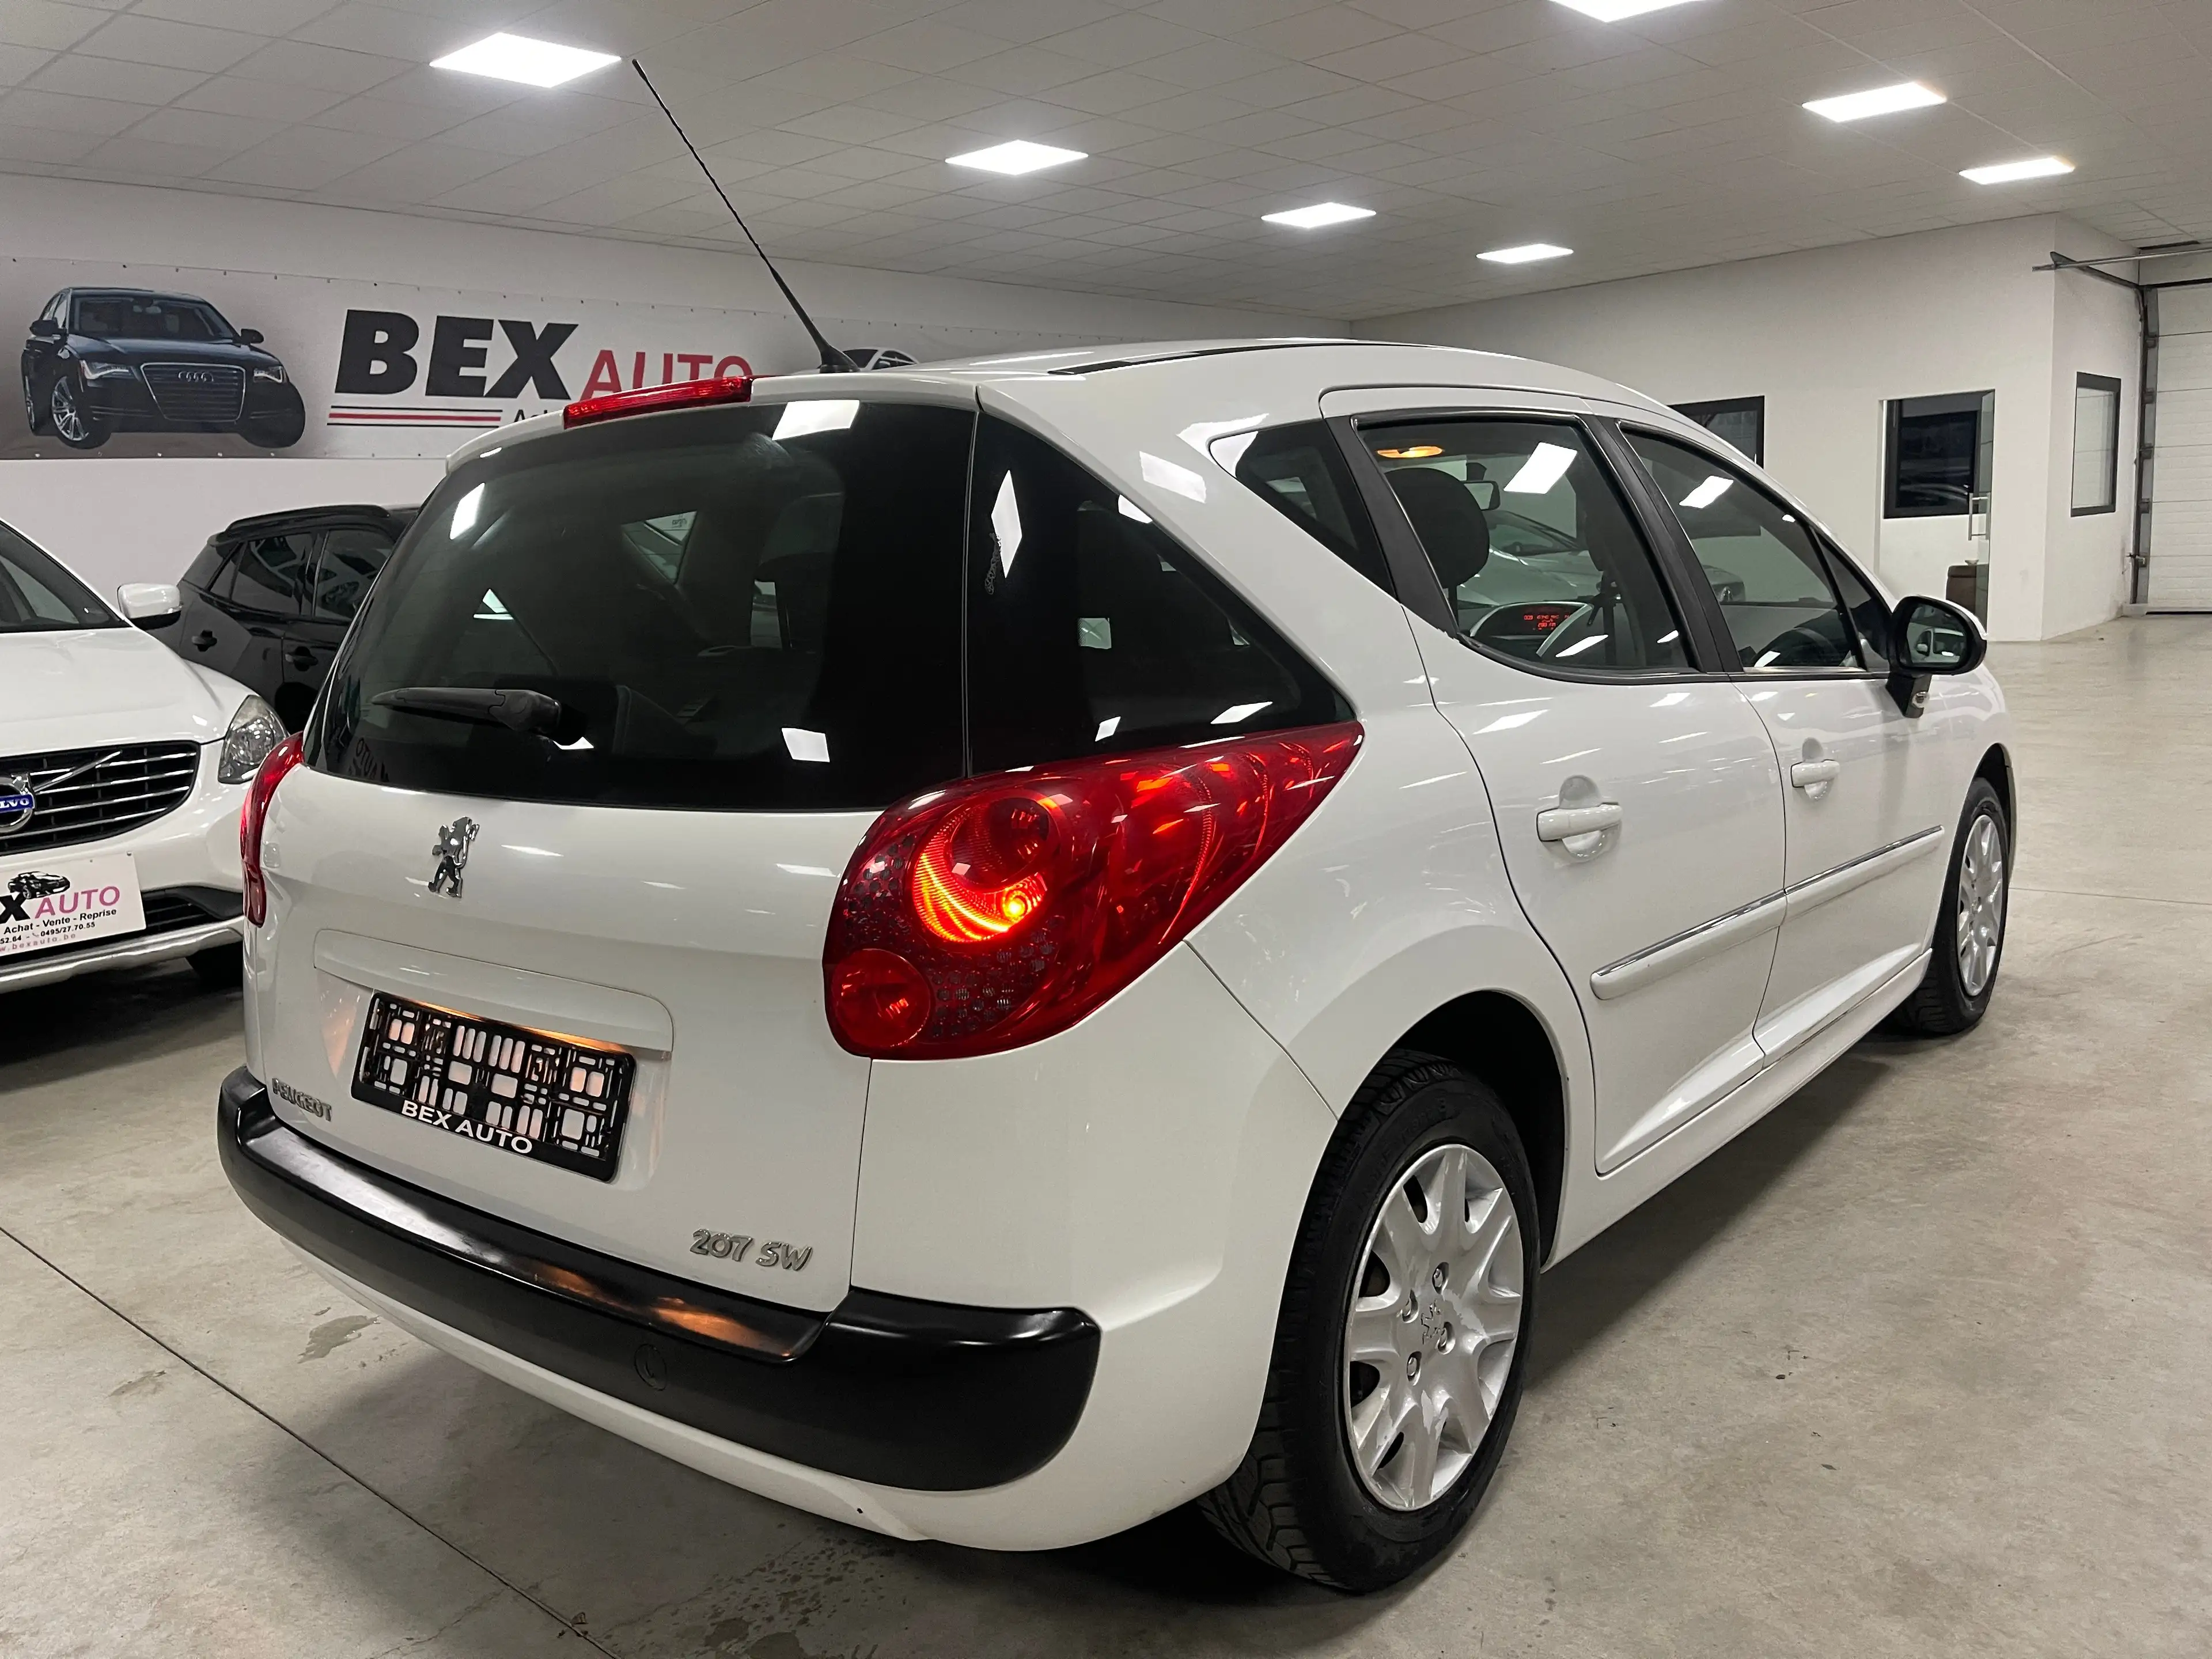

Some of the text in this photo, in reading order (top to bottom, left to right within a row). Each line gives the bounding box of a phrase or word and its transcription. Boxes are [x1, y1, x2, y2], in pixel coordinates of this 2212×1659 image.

[335, 309, 578, 400] BEX
[3, 923, 33, 934] Achat
[43, 917, 70, 927] Vente
[79, 908, 116, 922] Reprise
[35, 886, 120, 919] AUTO
[40, 922, 95, 937] 0495/27.70.55
[272, 1078, 332, 1122] PEUGEOT
[402, 1100, 532, 1154] BEX AUTO
[690, 1228, 812, 1271] 207 SW
